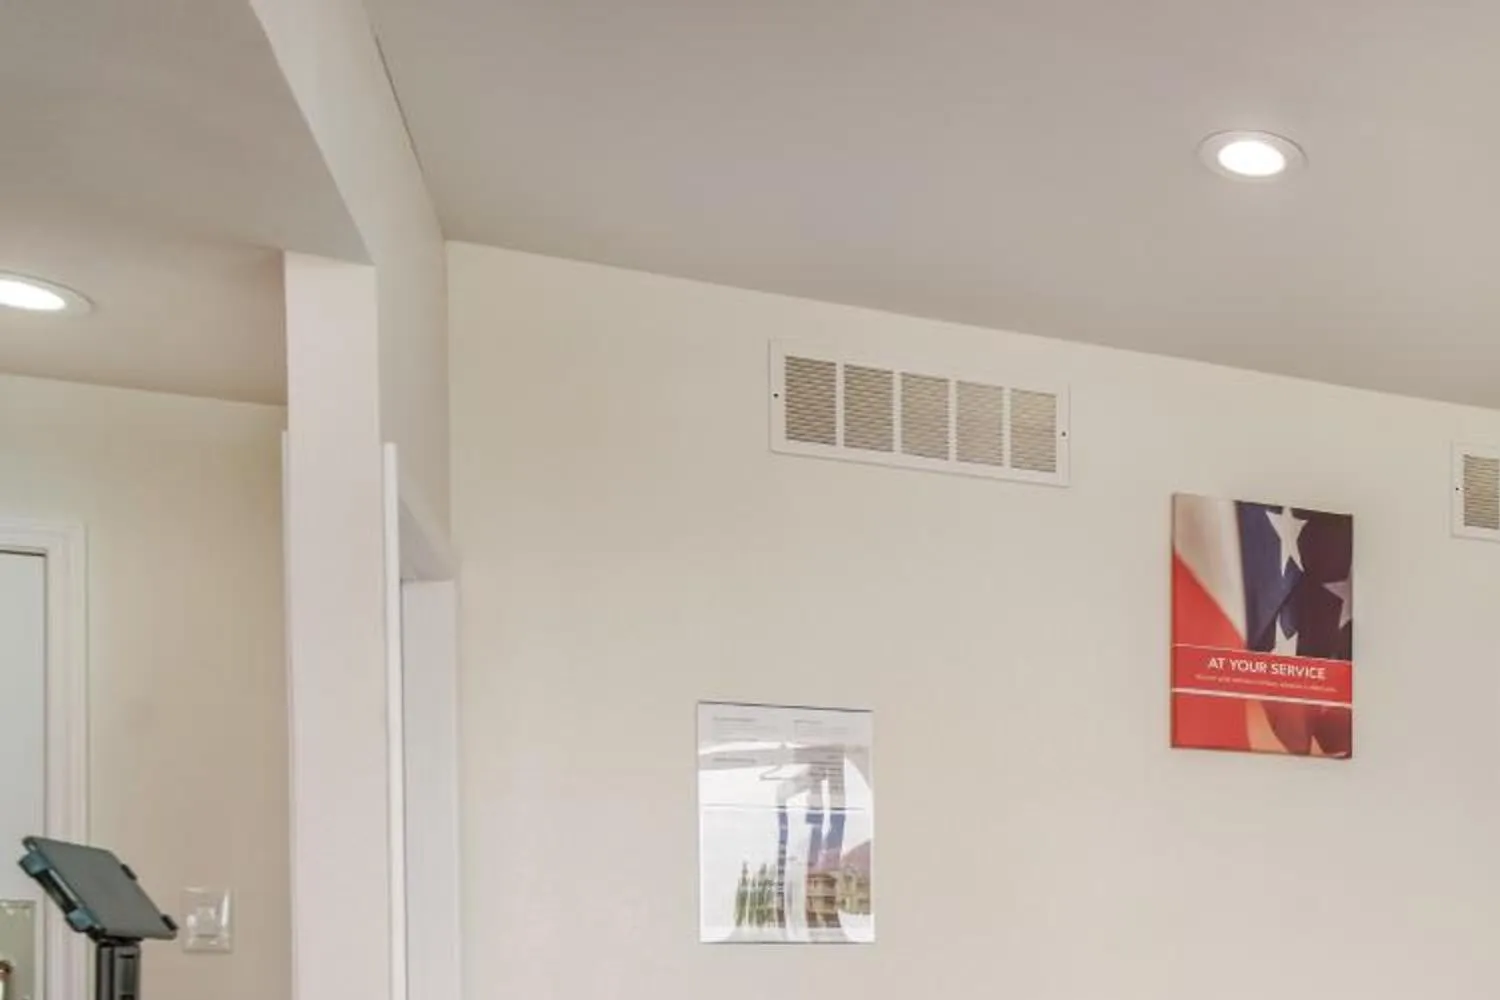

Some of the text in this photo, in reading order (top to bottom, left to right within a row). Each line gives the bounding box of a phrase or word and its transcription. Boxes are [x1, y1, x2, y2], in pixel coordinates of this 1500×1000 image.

[1207, 657, 1326, 680] AT YOUR SERVICE
